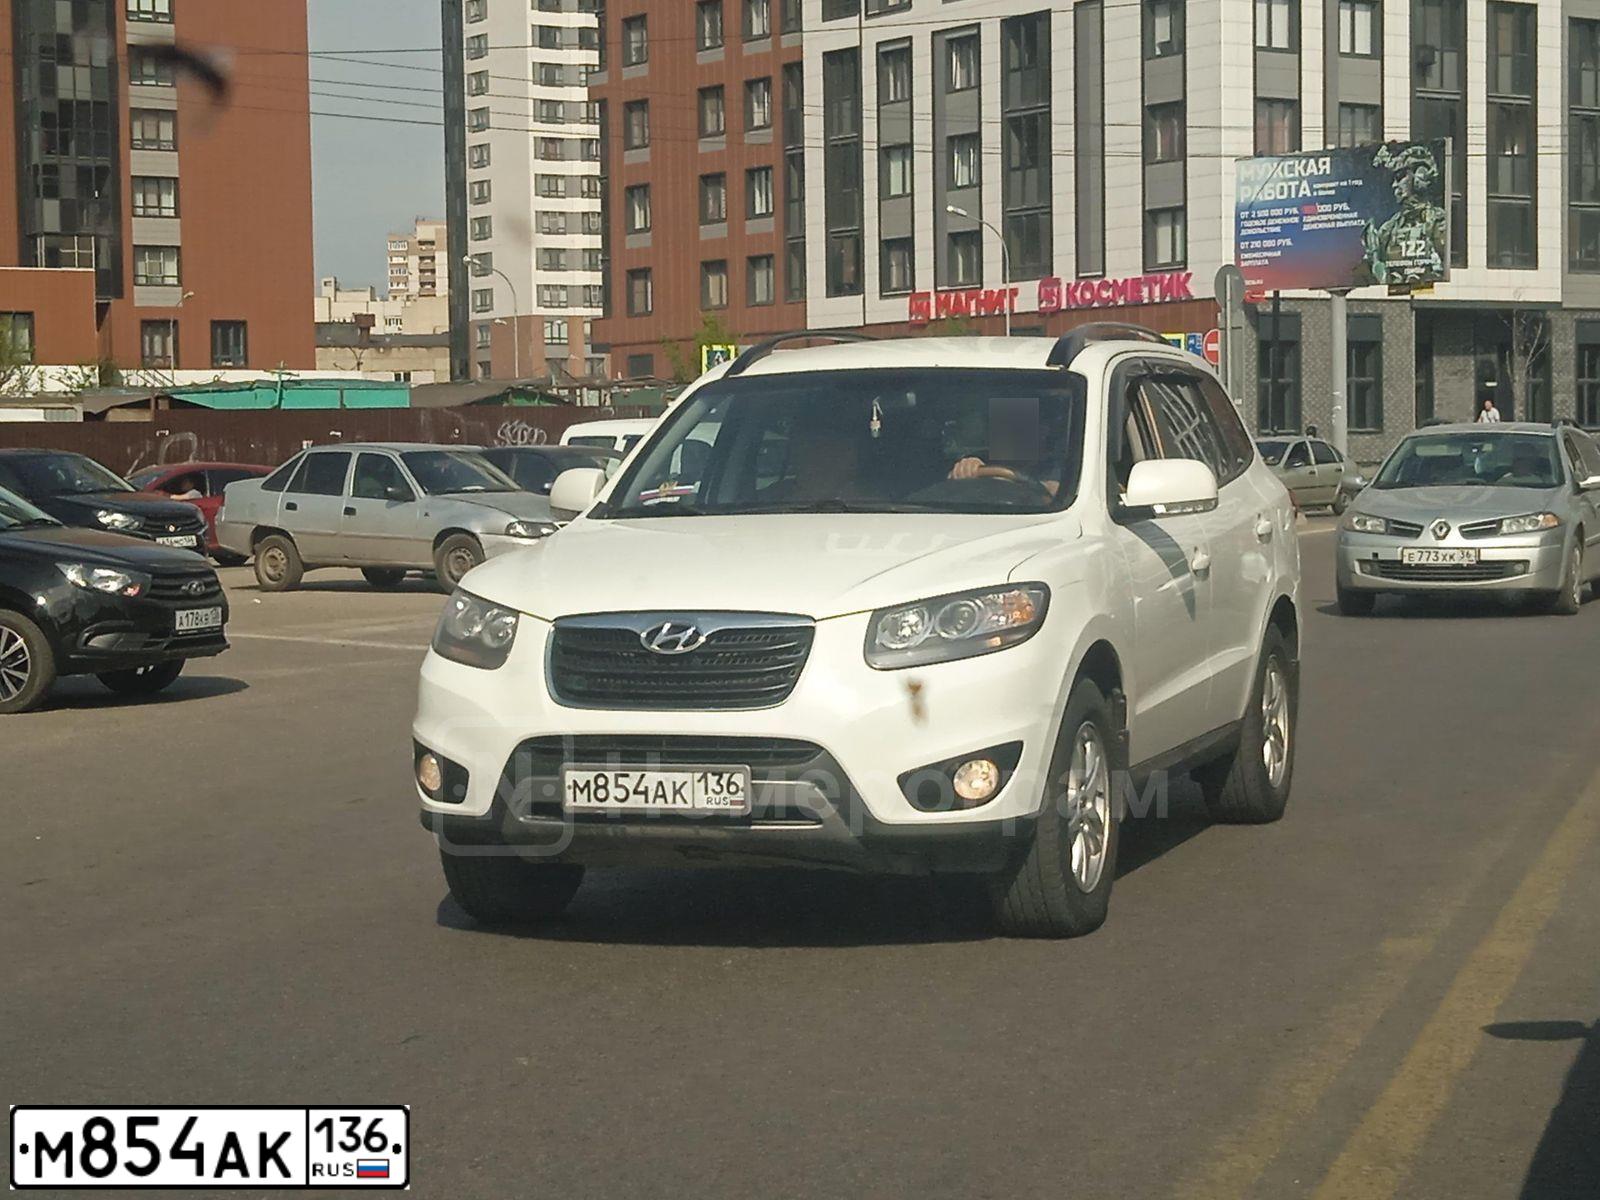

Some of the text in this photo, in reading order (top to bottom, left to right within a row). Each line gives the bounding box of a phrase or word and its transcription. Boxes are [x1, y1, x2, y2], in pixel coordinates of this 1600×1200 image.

[1241, 157, 1331, 182] МУЖСКАЯ
[1240, 179, 1312, 203] РАБОТА
[1240, 211, 1249, 219] ОТ
[1240, 241, 1250, 250] ОТ
[1399, 240, 1426, 257] 122
[1066, 272, 1194, 309] КОСМЕТИК
[935, 287, 1019, 317] МАГНИТ
[1407, 550, 1473, 562] Е773ХК 36
[572, 772, 740, 805] М854АК 136
[706, 796, 729, 806] RUS
